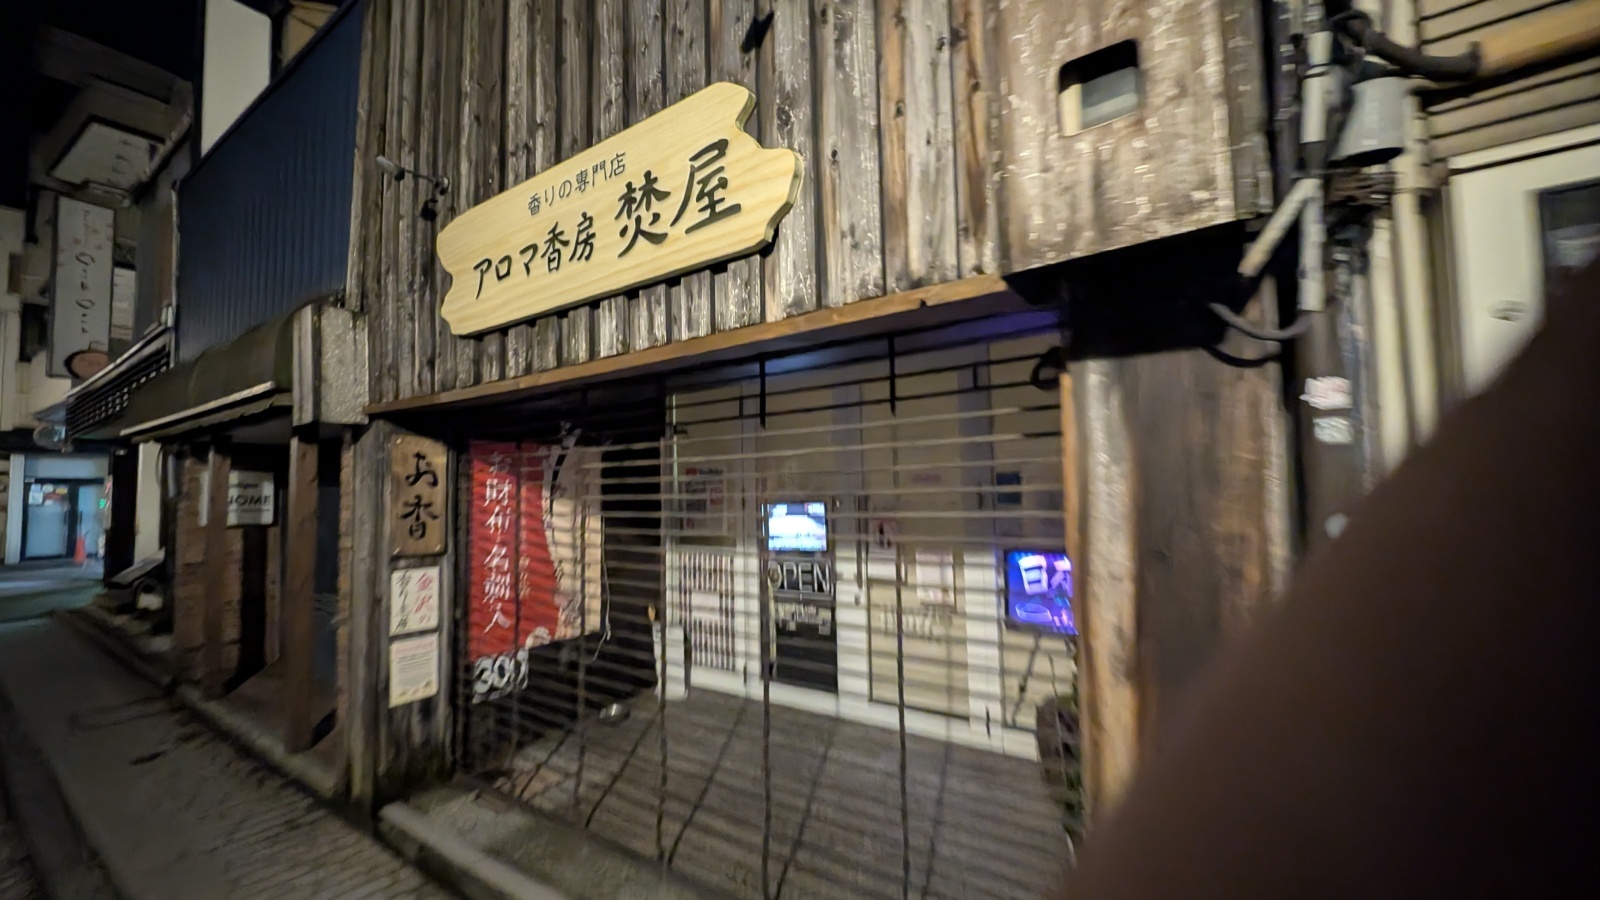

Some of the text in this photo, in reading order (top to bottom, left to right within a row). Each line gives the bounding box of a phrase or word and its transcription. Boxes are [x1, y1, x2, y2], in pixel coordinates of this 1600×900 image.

[472, 138, 742, 300] アロマ香房 焚屋
[527, 152, 627, 216] 香りの専門店
[400, 451, 440, 541] お香
[768, 559, 830, 593] OPEN
